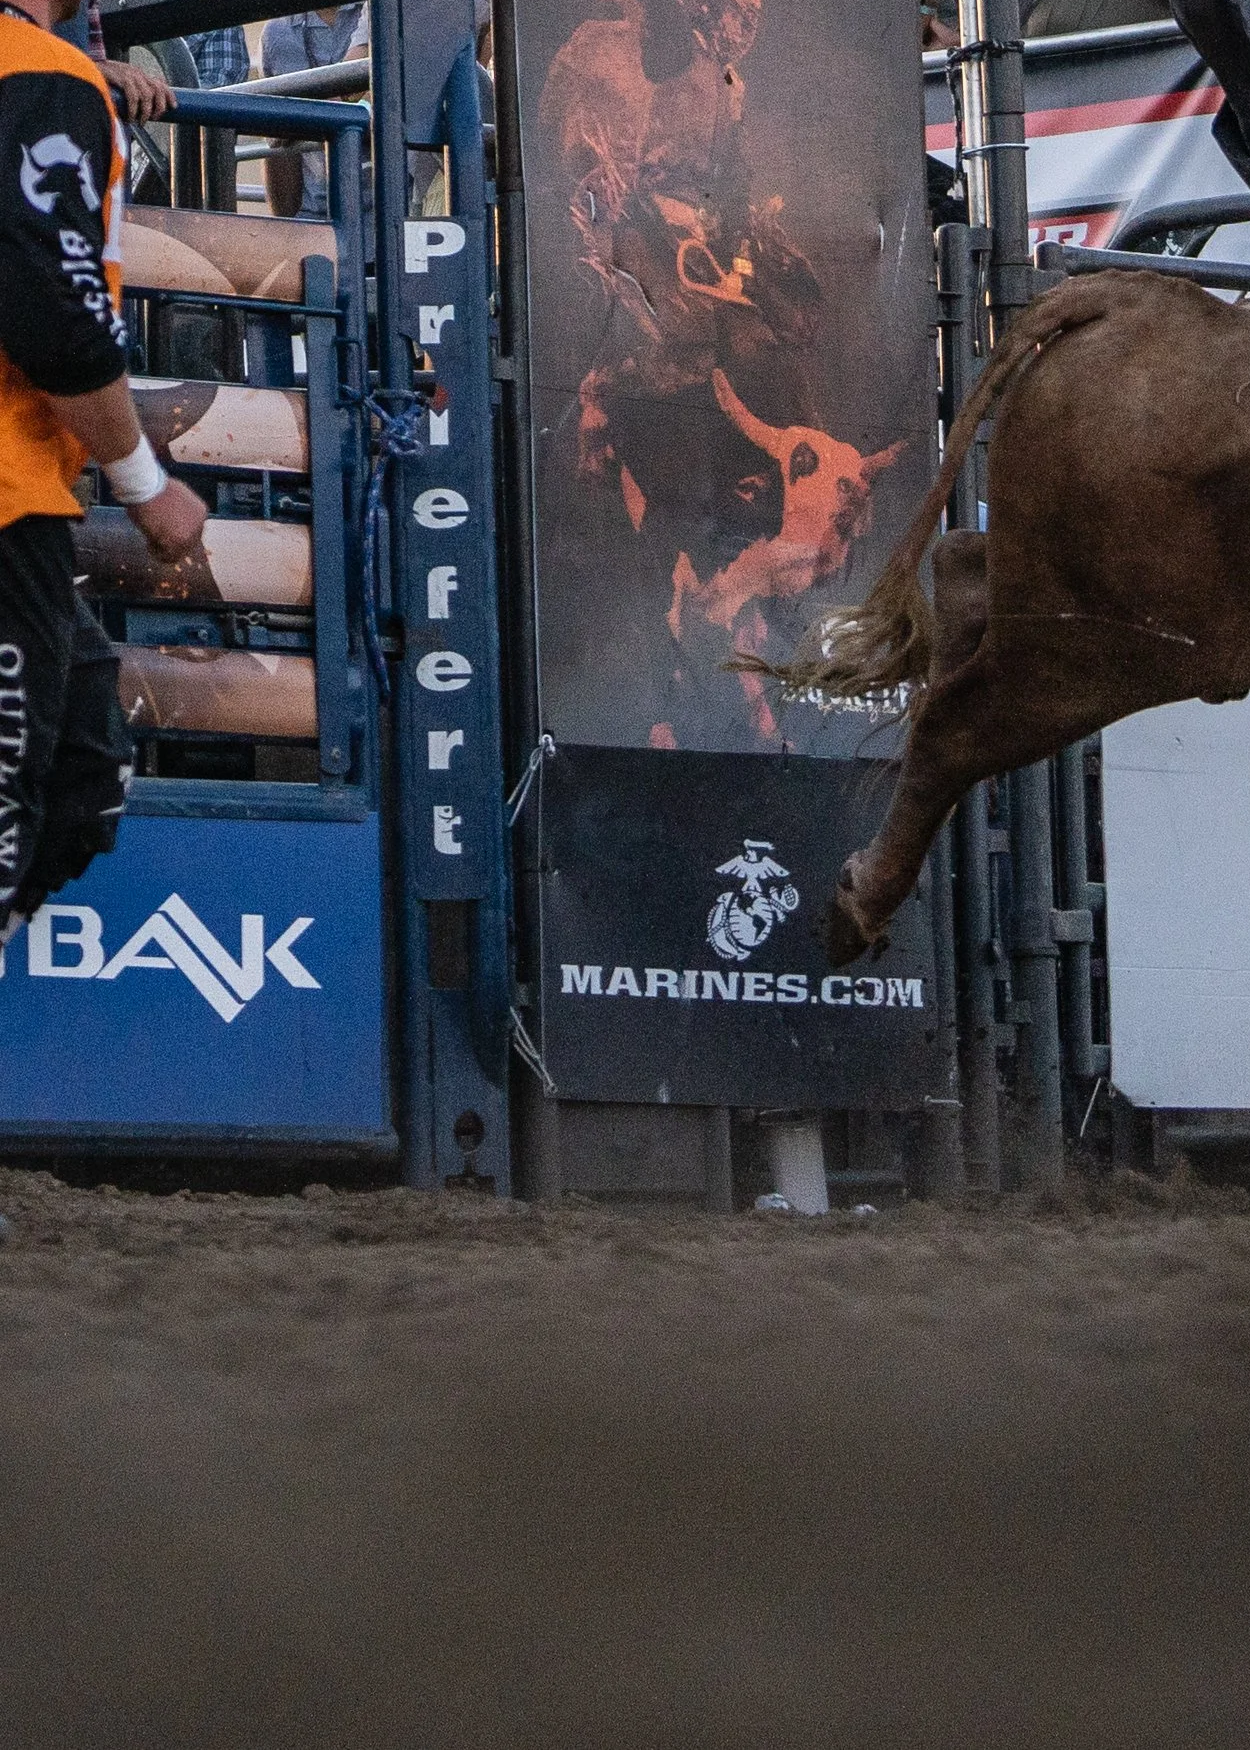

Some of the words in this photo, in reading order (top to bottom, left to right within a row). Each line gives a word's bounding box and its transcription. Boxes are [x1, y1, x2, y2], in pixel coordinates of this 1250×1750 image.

[402, 220, 474, 855] Priefert
[28, 891, 323, 1024] BANK
[560, 963, 925, 1008] MARINES.COM
